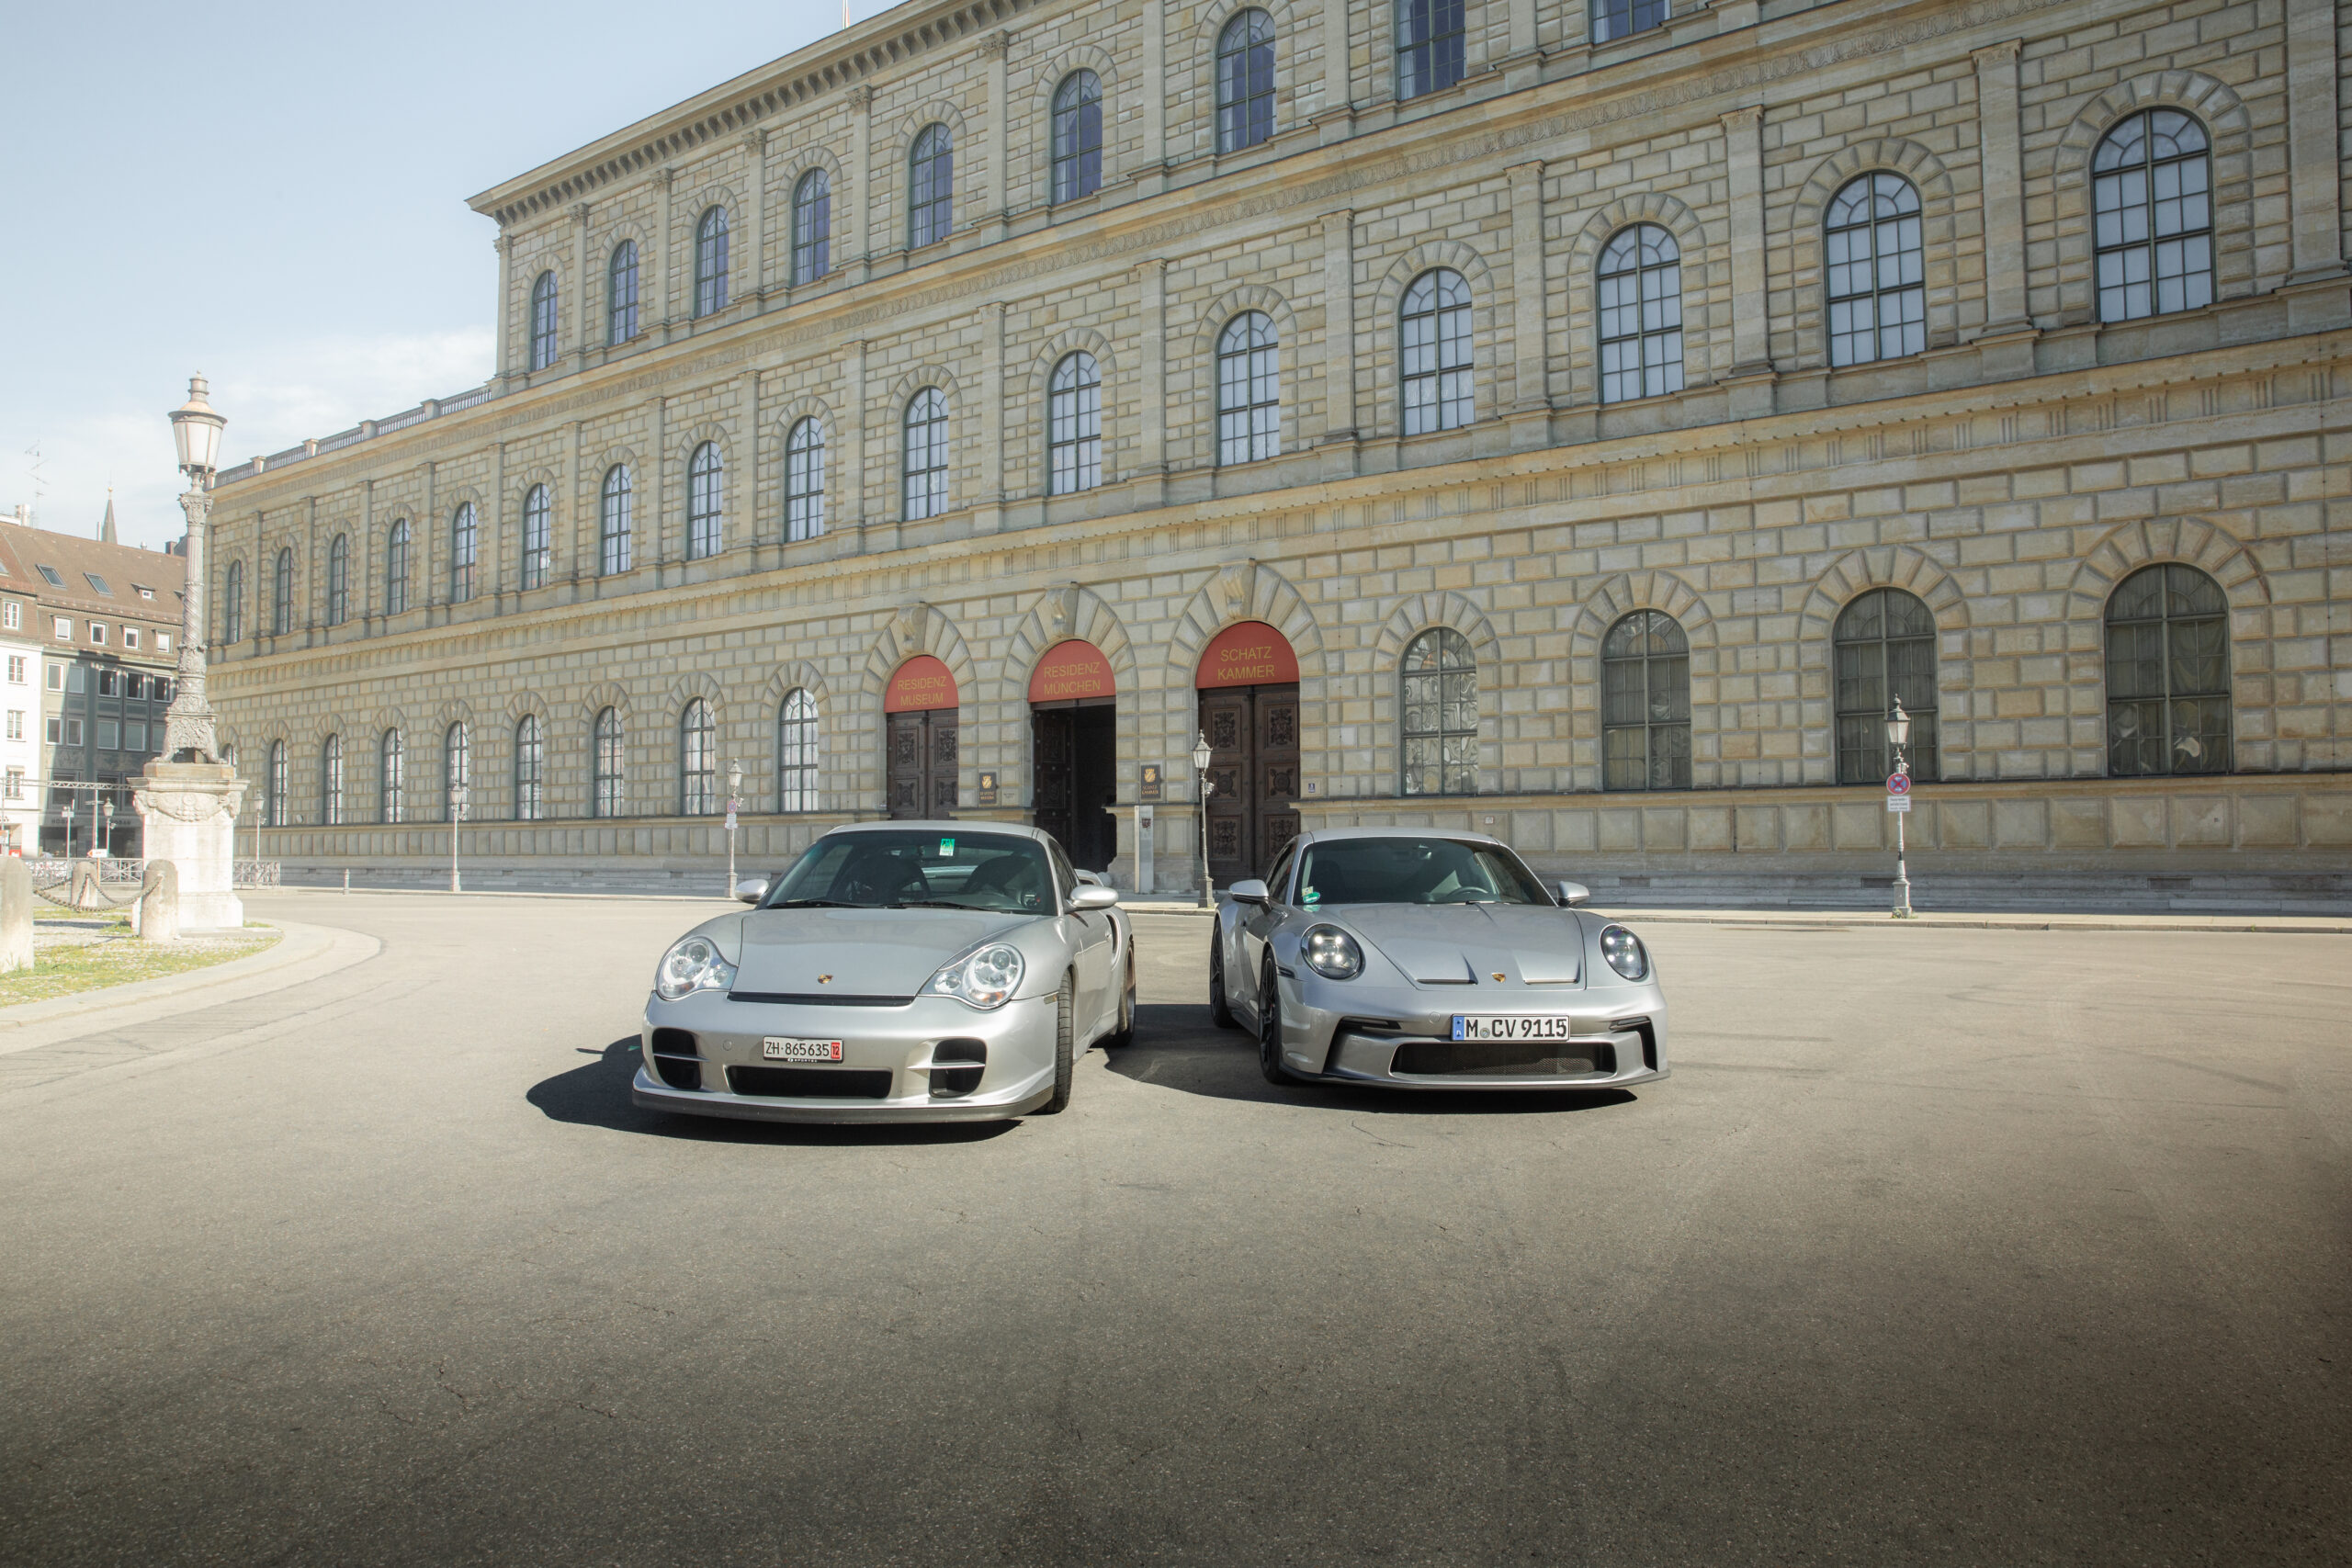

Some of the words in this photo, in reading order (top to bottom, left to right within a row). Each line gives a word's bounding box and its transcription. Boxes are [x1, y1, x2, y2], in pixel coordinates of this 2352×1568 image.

[1220, 646, 1272, 662] SCHATZ
[1044, 661, 1101, 678] RESIDENZ
[1217, 664, 1275, 681] KAMMER
[897, 675, 947, 691] RESIDENZ
[1044, 679, 1101, 695] MÜNCHEN
[900, 693, 944, 706] MUSEUM
[1465, 1019, 1478, 1038] M
[1491, 1019, 1517, 1038] CV
[1521, 1019, 1567, 1038] 9115
[832, 1045, 840, 1056] 12
